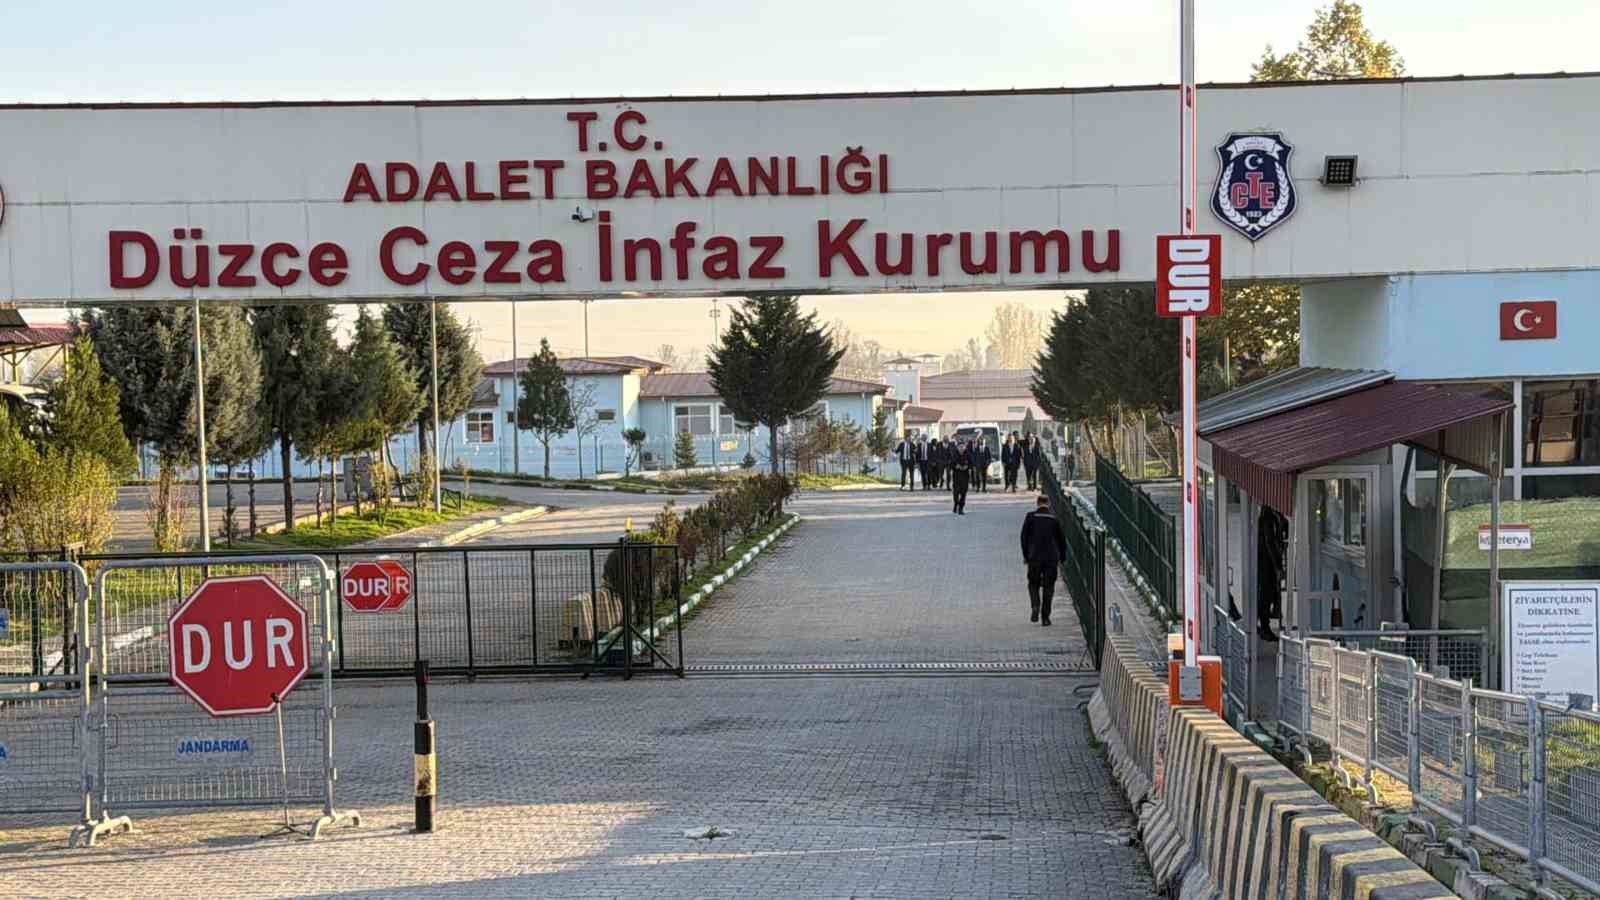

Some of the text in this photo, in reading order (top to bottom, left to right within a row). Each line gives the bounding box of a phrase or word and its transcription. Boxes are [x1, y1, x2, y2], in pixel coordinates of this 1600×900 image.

[567, 110, 664, 152] T.C.
[344, 146, 889, 203] ADALET BAKANLIĞI
[1231, 172, 1275, 208] CTE
[109, 211, 1121, 289] Düzce Ceza İnfaz Kurumu
[1168, 239, 1210, 312] DUR
[344, 578, 389, 597] DUR
[181, 617, 296, 674] DUR
[177, 740, 249, 753] JANDARMA
